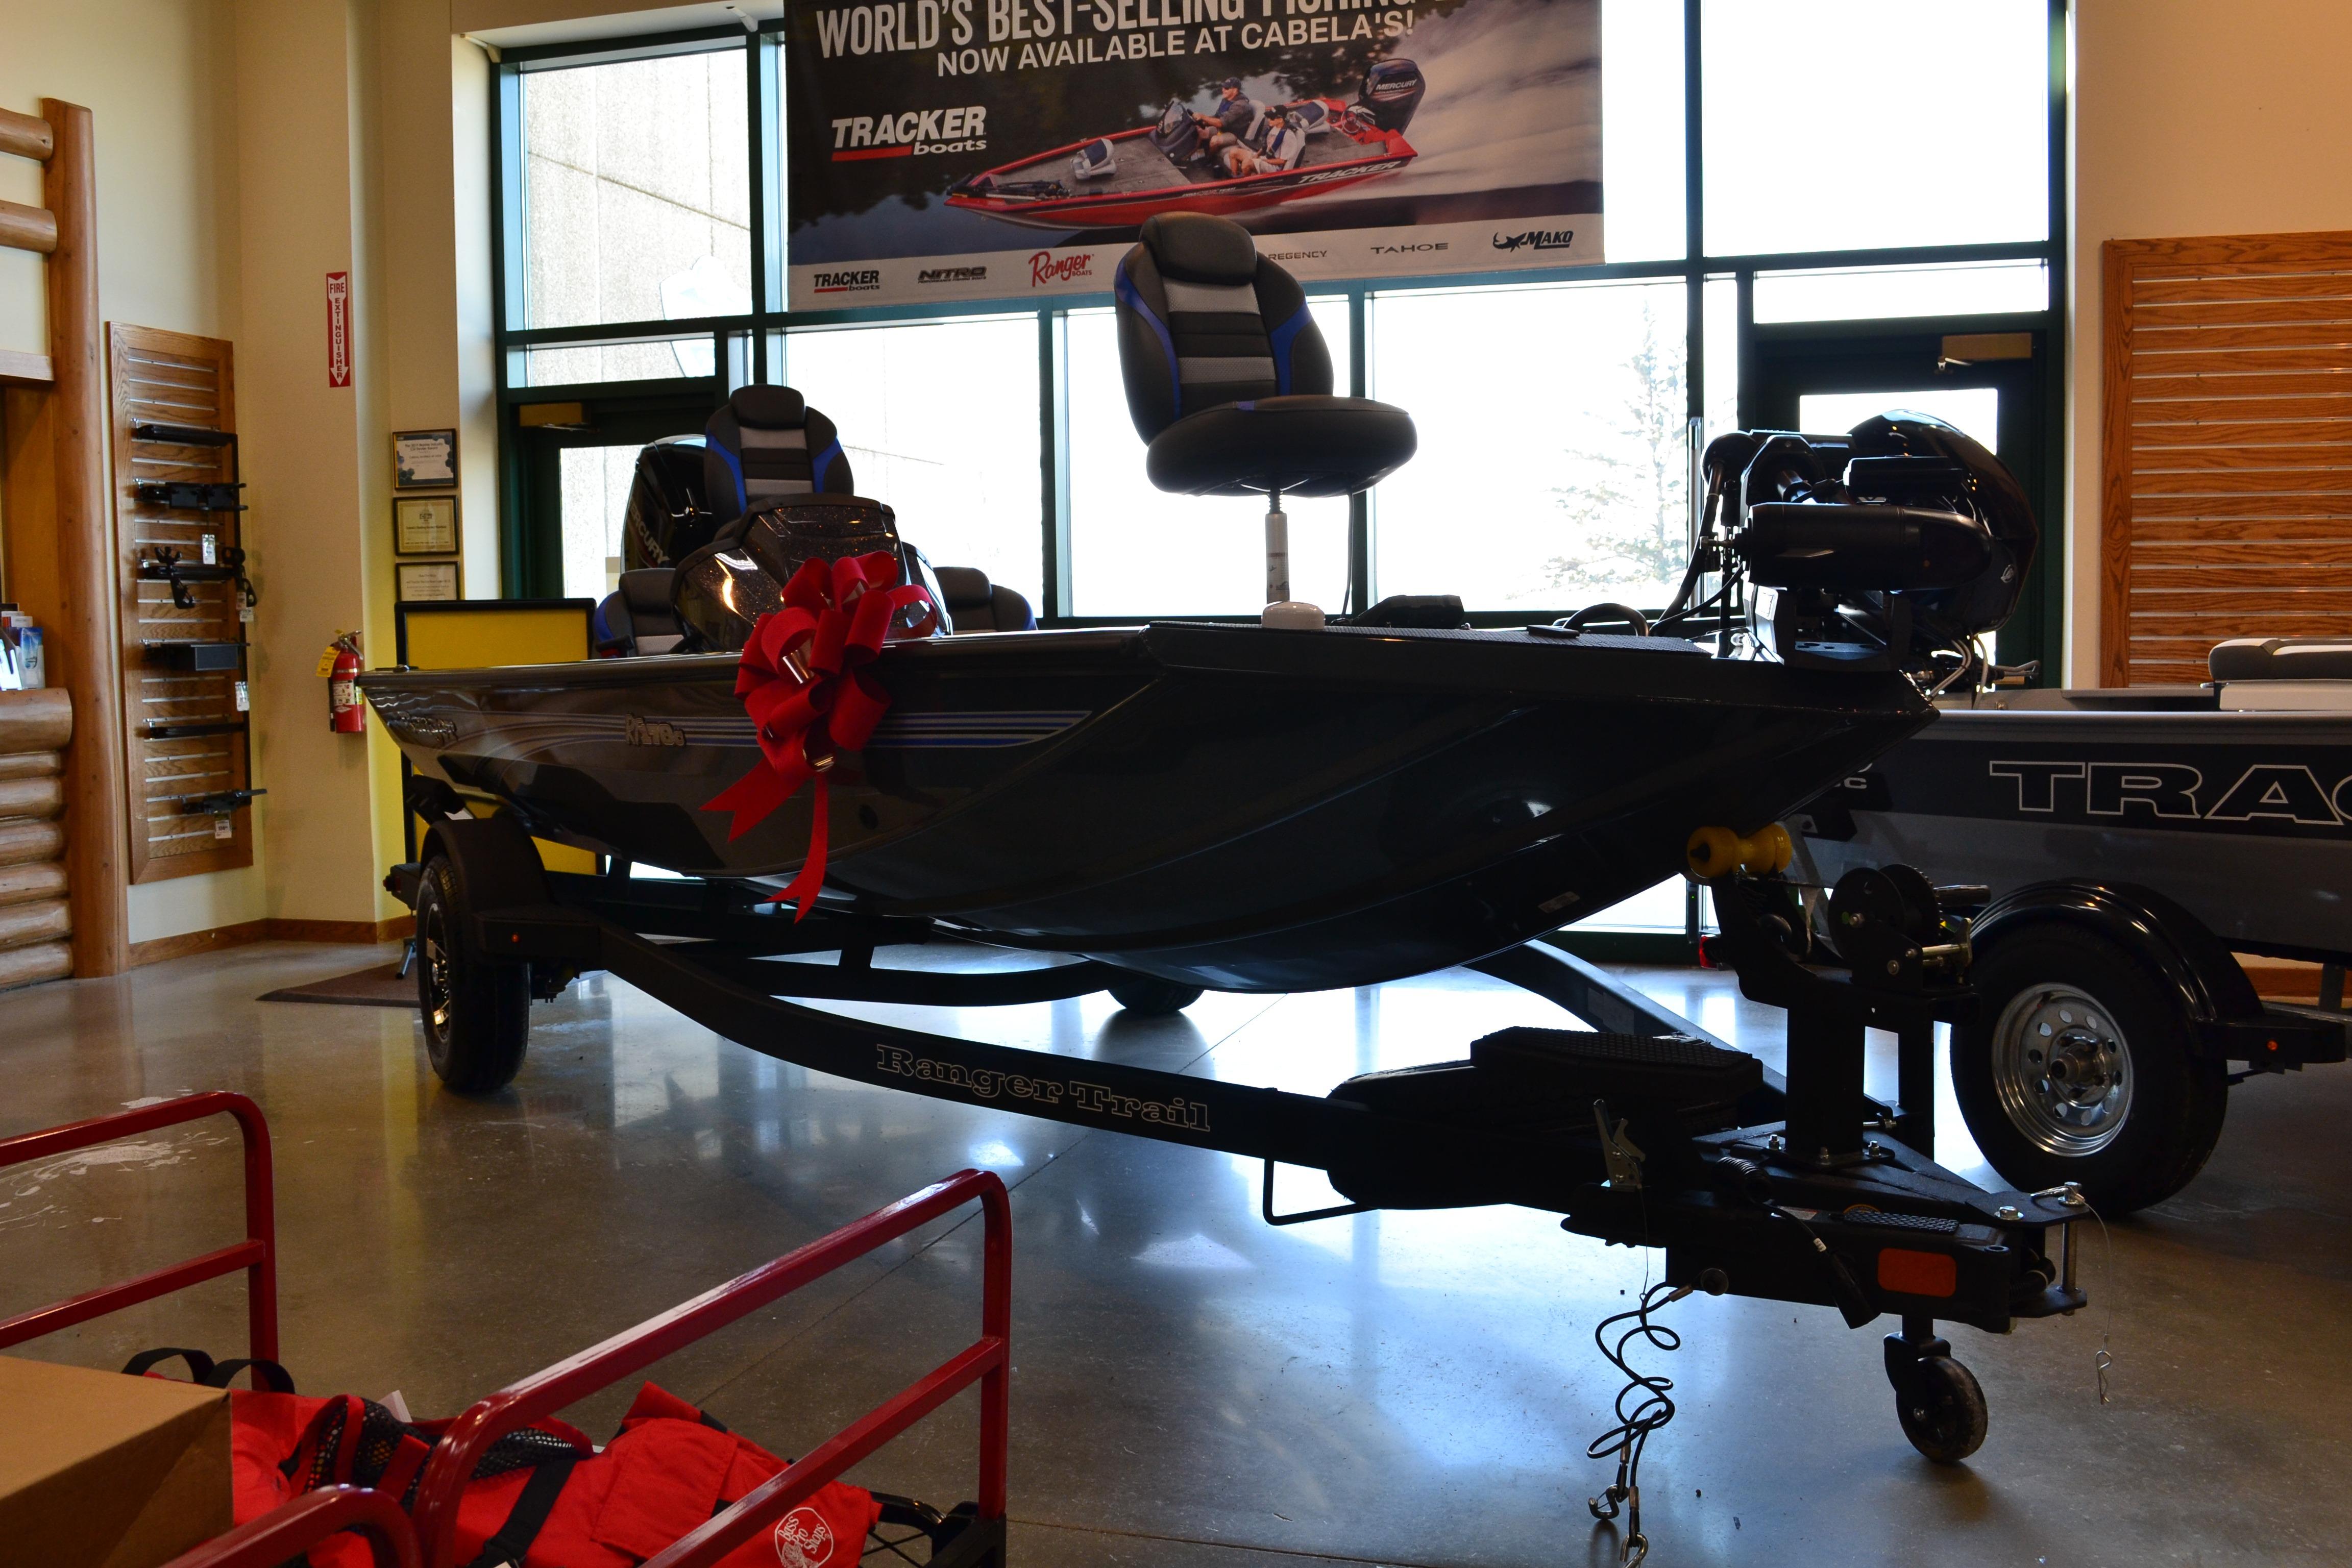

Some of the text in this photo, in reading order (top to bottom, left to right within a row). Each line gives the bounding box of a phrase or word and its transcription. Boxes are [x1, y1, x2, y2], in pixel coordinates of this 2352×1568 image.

[938, 9, 1414, 77] NOW AVAILABLE AT CABELA'S!
[1376, 79, 1417, 90] MERCURY
[831, 106, 987, 149] TRACKER
[913, 140, 987, 156] boats
[1298, 160, 1401, 184] TRACKER
[1371, 243, 1449, 255] TAHOE
[1520, 231, 1574, 250] MAKO
[1268, 250, 1328, 261] REGENCY
[814, 270, 879, 287] TRACKER
[919, 266, 987, 280] NITRO
[1028, 251, 1091, 287] Ranger
[330, 282, 345, 294] FIRE
[630, 502, 670, 565] ERCURY
[1990, 761, 2352, 825] TRA
[877, 1044, 1210, 1133] Ranger Trail
[778, 1516, 799, 1541] Bass
[791, 1528, 808, 1548] Pro
[804, 1524, 826, 1554] Shops
